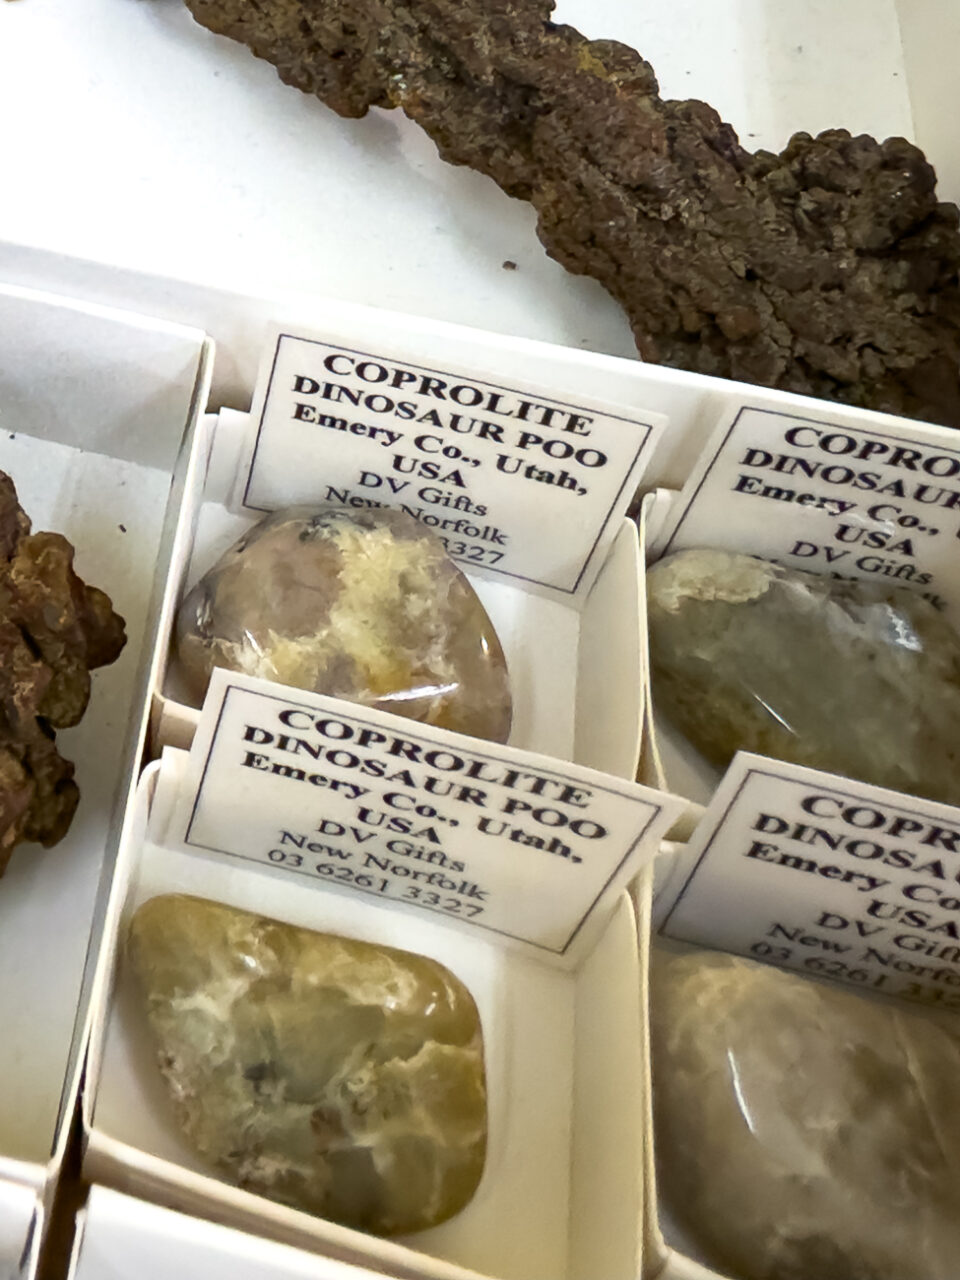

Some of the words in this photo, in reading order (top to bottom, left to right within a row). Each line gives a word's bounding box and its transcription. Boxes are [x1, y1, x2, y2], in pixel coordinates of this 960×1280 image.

[291, 374, 505, 444] DINOSAUR
[516, 430, 608, 469] POO
[324, 354, 594, 437] COPROLITE
[291, 403, 404, 448] Emery
[414, 435, 482, 468] Co.,
[497, 454, 588, 497] Utah,
[392, 454, 466, 489] USA
[358, 470, 411, 494] DV
[418, 487, 489, 518] Gifts
[731, 474, 857, 517] Emery
[867, 504, 940, 536] Co.,
[401, 504, 510, 547] Norfolk
[834, 524, 915, 557] USA
[789, 540, 851, 563] DV
[856, 555, 935, 585] Gifts
[241, 724, 489, 808] DINOSAUR
[501, 797, 609, 841] POO
[278, 708, 596, 810] COPROLITE
[240, 751, 370, 801] Emery
[383, 791, 461, 828] Co.,
[476, 816, 584, 865] Utah,
[357, 807, 443, 846] USA
[278, 831, 355, 861] New
[363, 853, 491, 903] Norfolk
[317, 820, 378, 846] DV
[386, 840, 466, 874] Gifts
[744, 840, 891, 892] Emery
[267, 848, 304, 869] 03
[316, 861, 389, 893] 6261
[402, 884, 486, 918] 3327
[766, 922, 854, 954] New
[814, 912, 886, 938] DV
[866, 900, 960, 940] USA
[750, 942, 793, 961] 03
